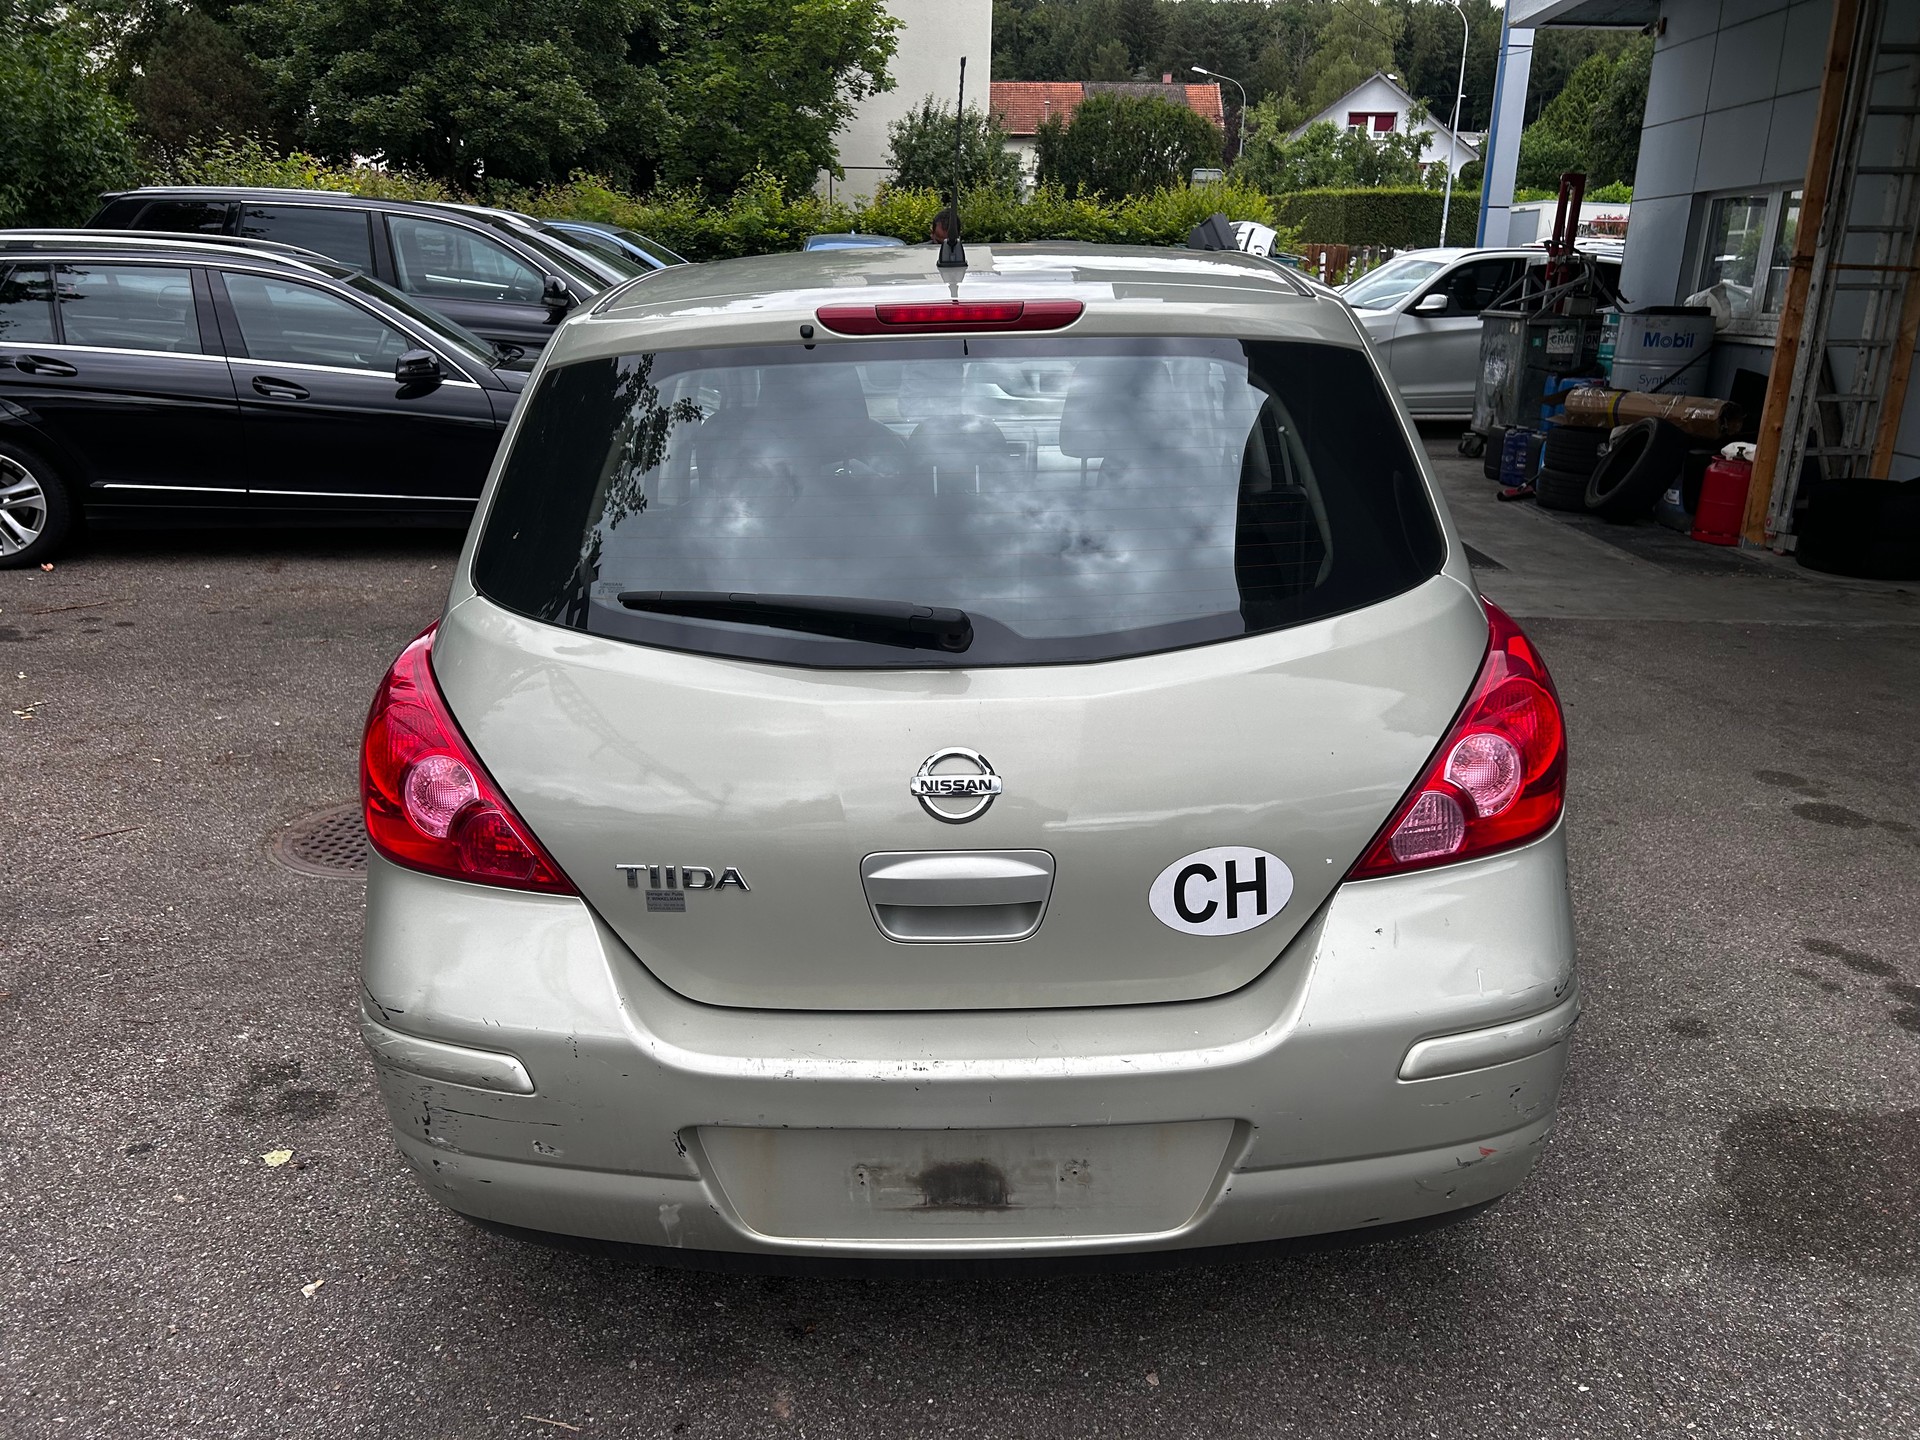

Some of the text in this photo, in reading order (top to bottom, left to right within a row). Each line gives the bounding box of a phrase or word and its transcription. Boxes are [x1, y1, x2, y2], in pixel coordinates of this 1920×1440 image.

[1643, 332, 1695, 348] Mobil
[920, 779, 992, 792] NISSAN
[615, 864, 751, 891] TIIDA
[1173, 856, 1267, 924] CH
